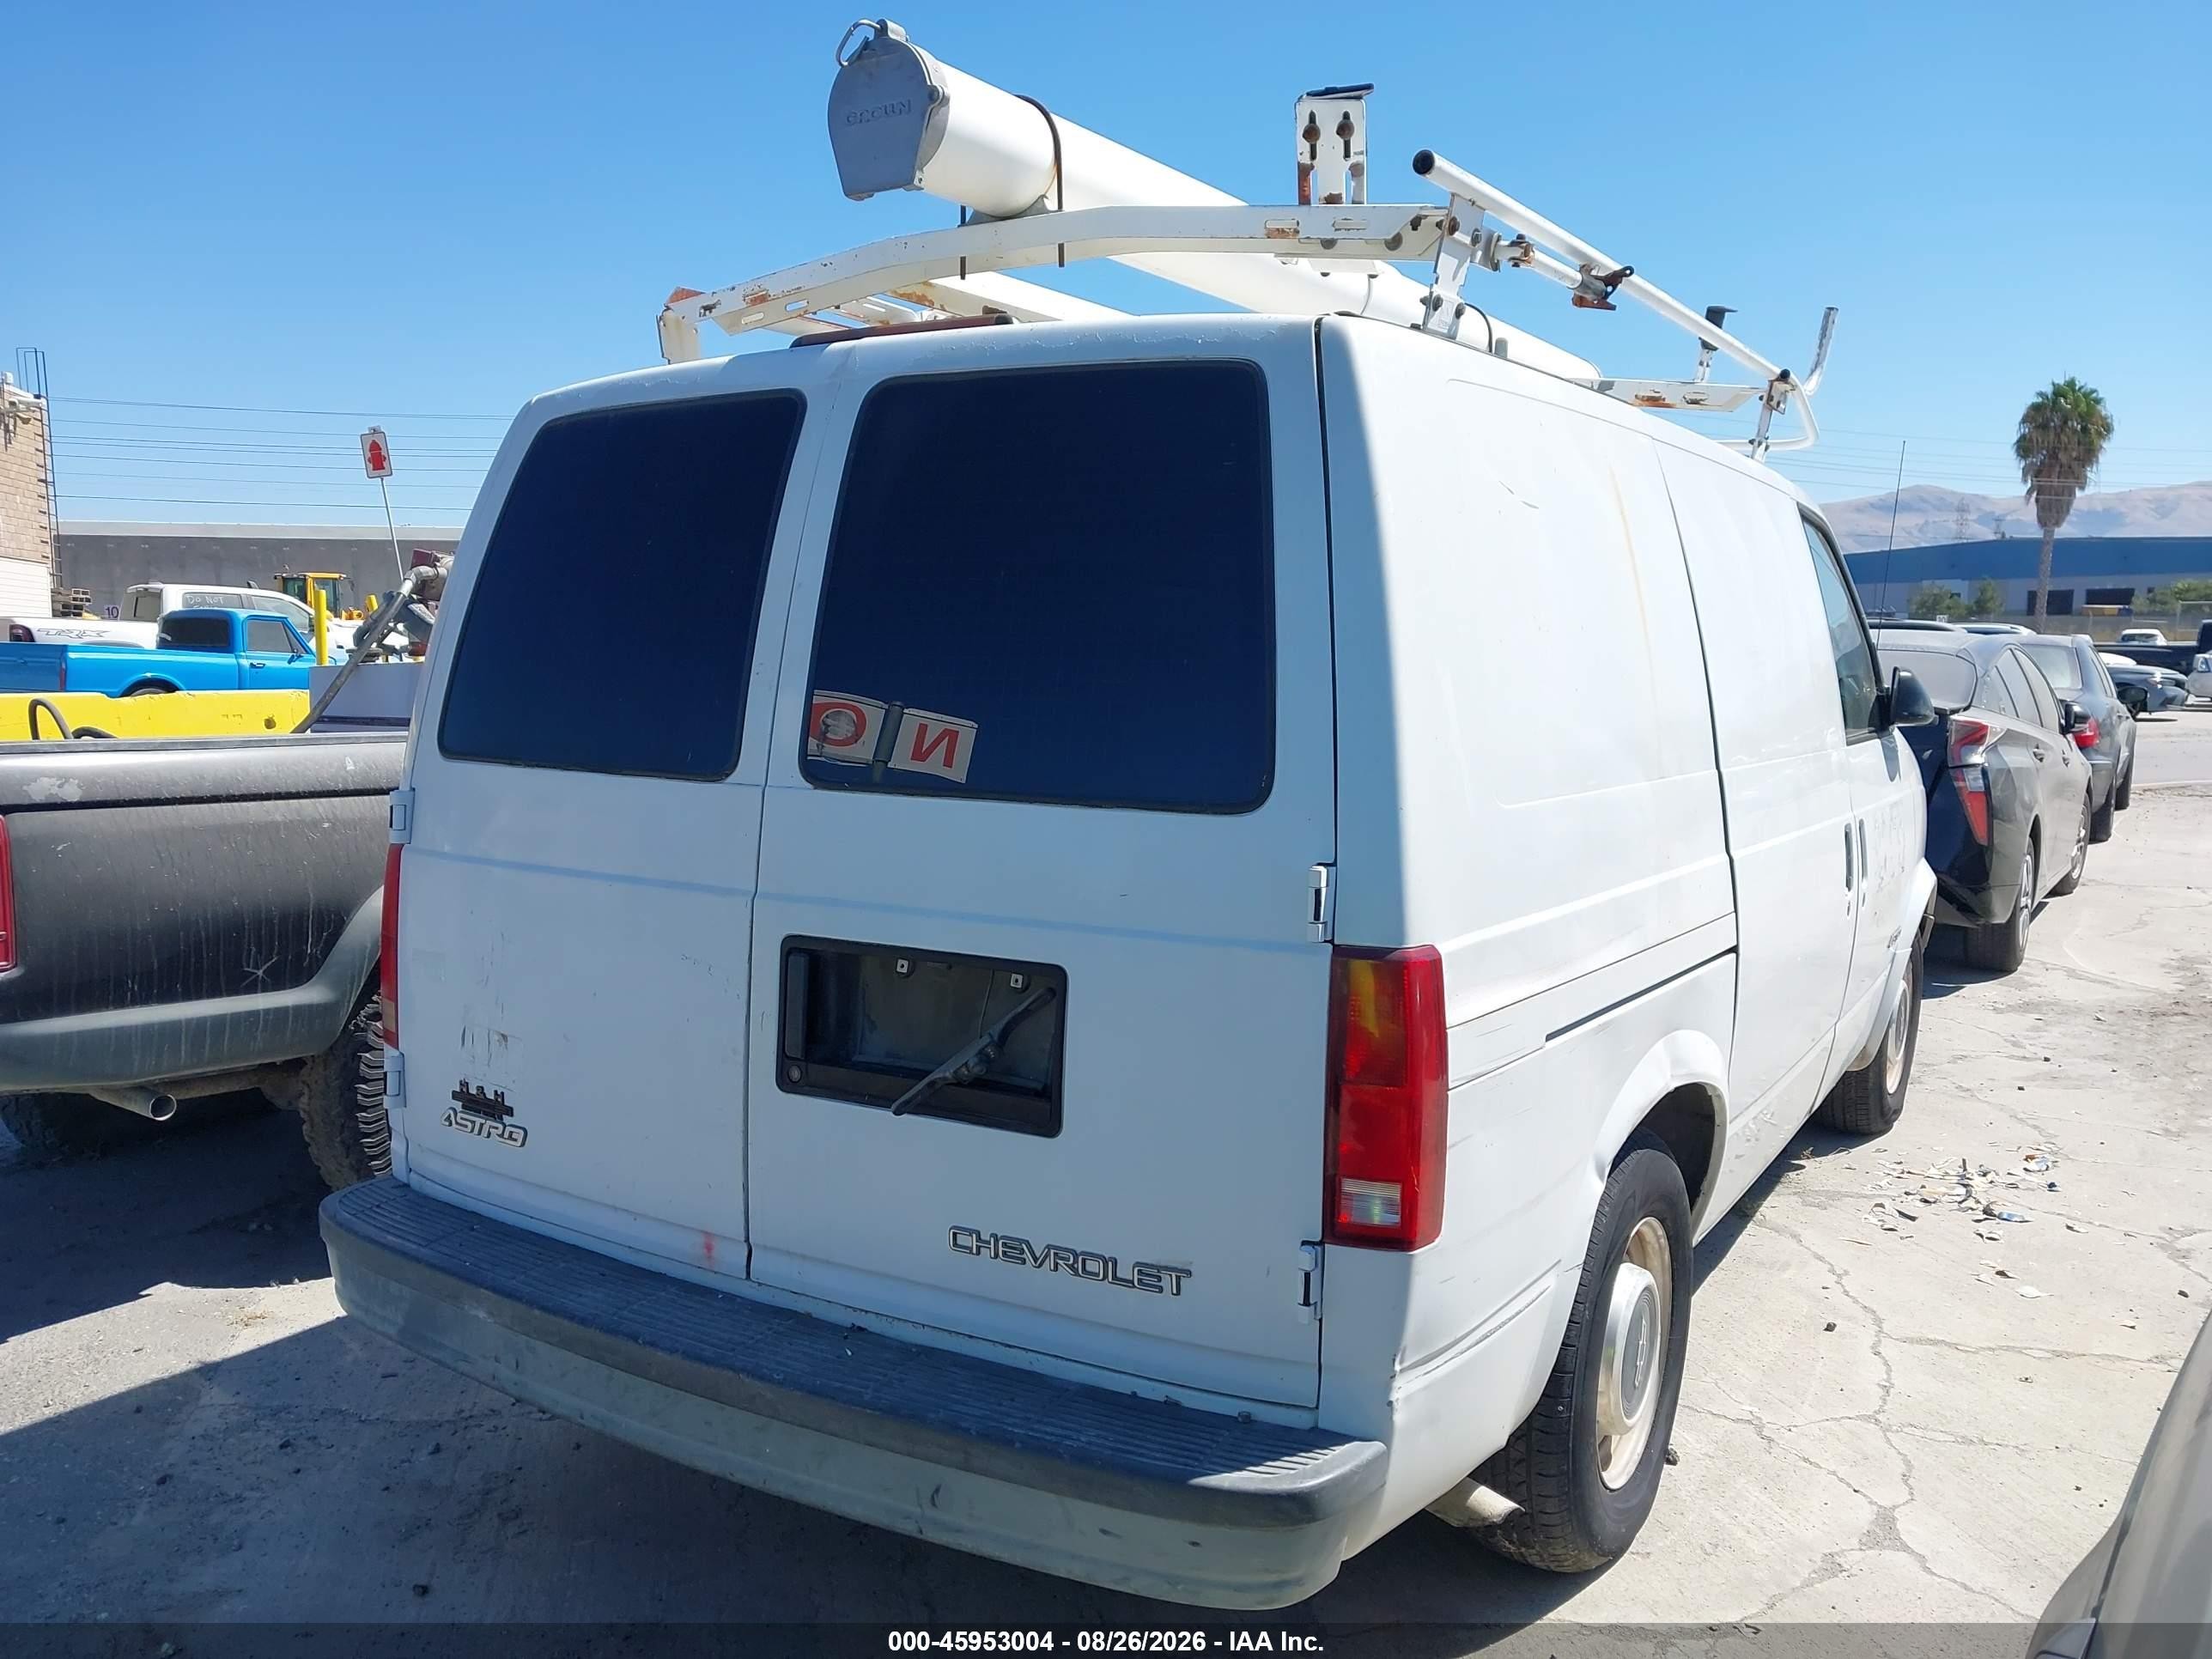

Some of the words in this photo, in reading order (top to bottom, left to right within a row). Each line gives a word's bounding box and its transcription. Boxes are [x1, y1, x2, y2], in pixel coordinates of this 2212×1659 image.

[205, 595, 224, 605] NOT
[105, 606, 119, 618] 10
[37, 628, 110, 639] TRX
[441, 1106, 528, 1148] ASTRO
[948, 1225, 1192, 1296] CHEVROLET
